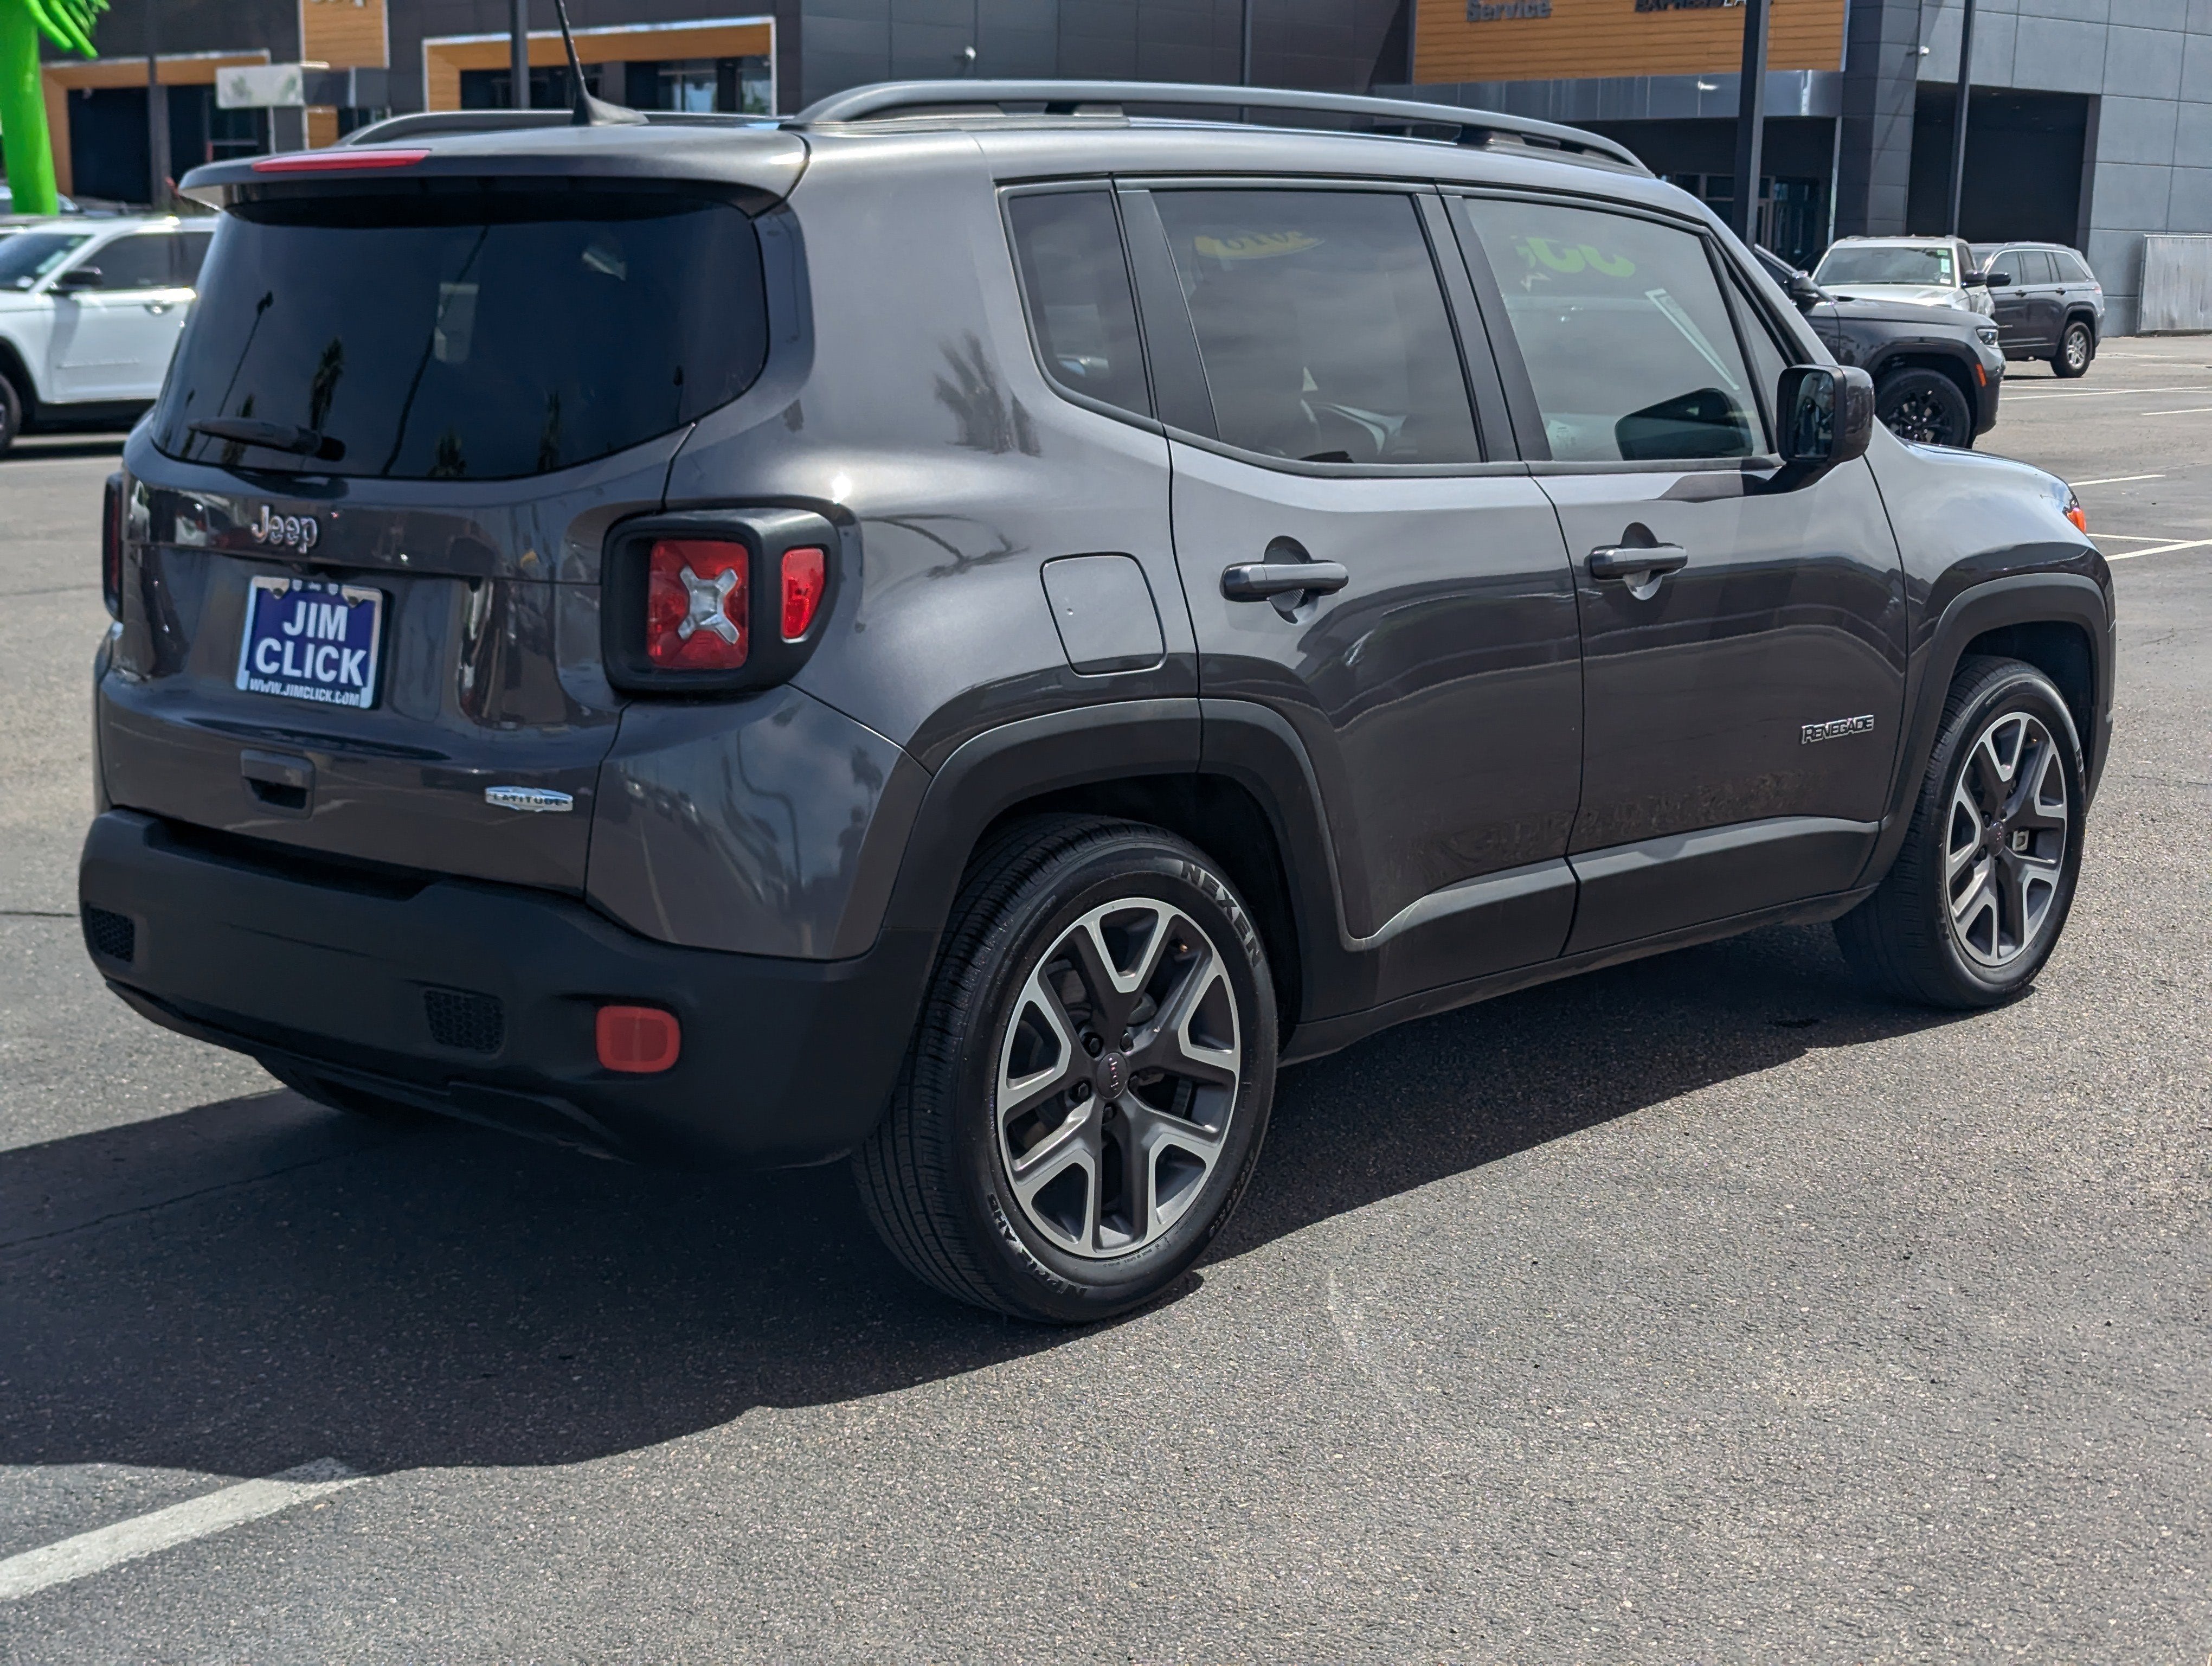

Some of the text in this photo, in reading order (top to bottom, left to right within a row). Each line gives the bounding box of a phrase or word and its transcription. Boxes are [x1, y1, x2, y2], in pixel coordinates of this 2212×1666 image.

[1467, 0, 1553, 22] Service
[251, 505, 318, 554] Jeep
[282, 600, 349, 642] JIM
[254, 637, 367, 687] CLICK
[1802, 714, 1874, 745] RENEGADE
[492, 792, 566, 806] LATITUDE
[1181, 860, 1263, 967] NEXEN
